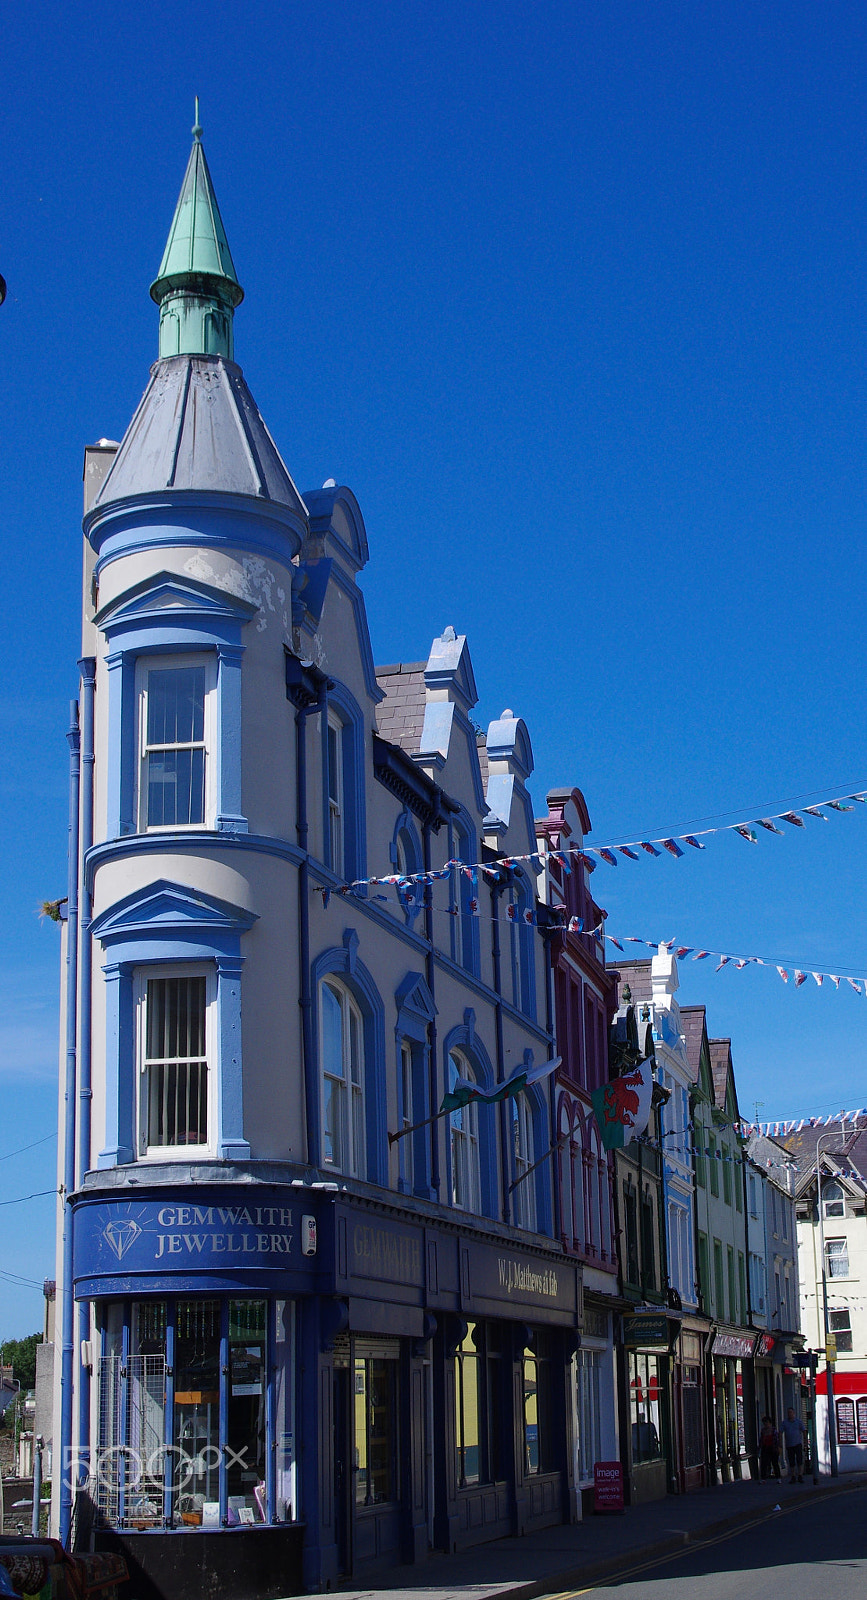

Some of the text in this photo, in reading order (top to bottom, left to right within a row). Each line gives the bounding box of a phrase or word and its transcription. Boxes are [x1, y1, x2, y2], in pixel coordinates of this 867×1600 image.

[157, 1207, 293, 1227] GEMWAITH
[155, 1233, 293, 1258] JEWELLERY
[354, 1224, 419, 1267] GEMWAITH
[514, 1262, 542, 1294] Matthews
[625, 1318, 665, 1332] James
[596, 1468, 620, 1479] image
